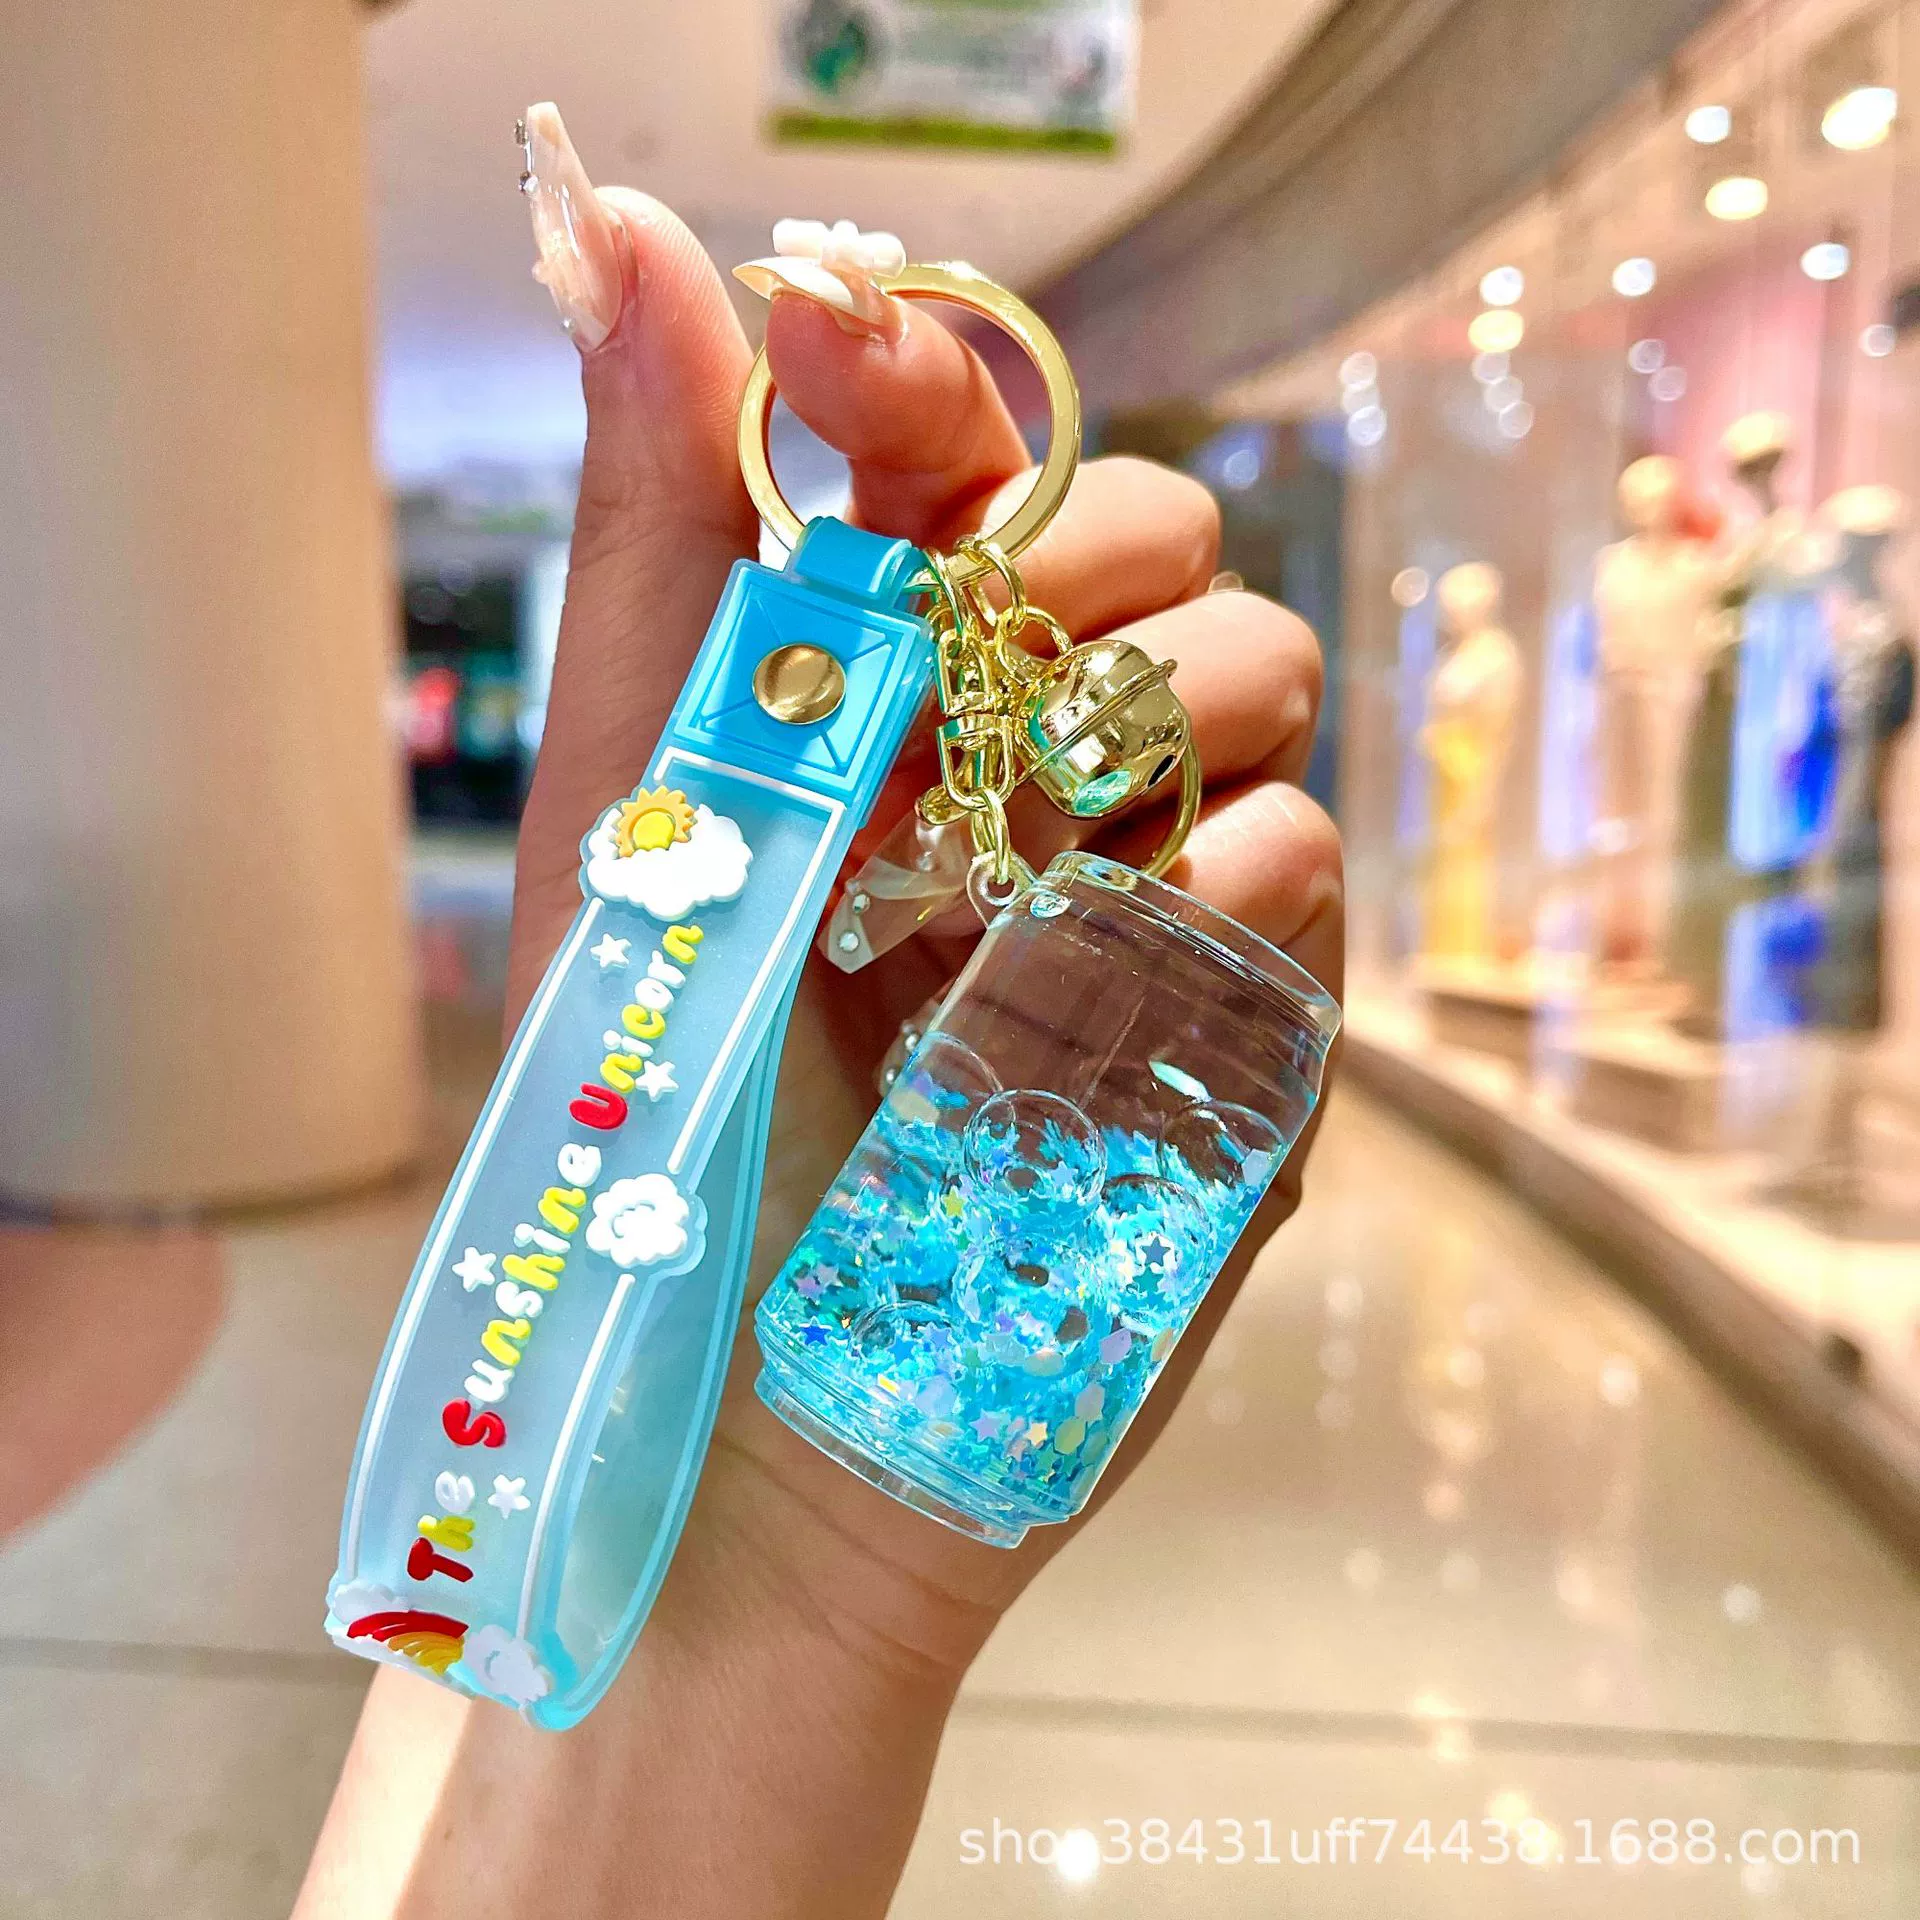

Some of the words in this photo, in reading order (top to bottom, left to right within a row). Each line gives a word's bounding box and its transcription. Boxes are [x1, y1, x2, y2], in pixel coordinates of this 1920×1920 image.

[407, 1471, 475, 1582] The
[442, 1143, 602, 1448] Sunshine
[569, 925, 703, 1130] Unicorn
